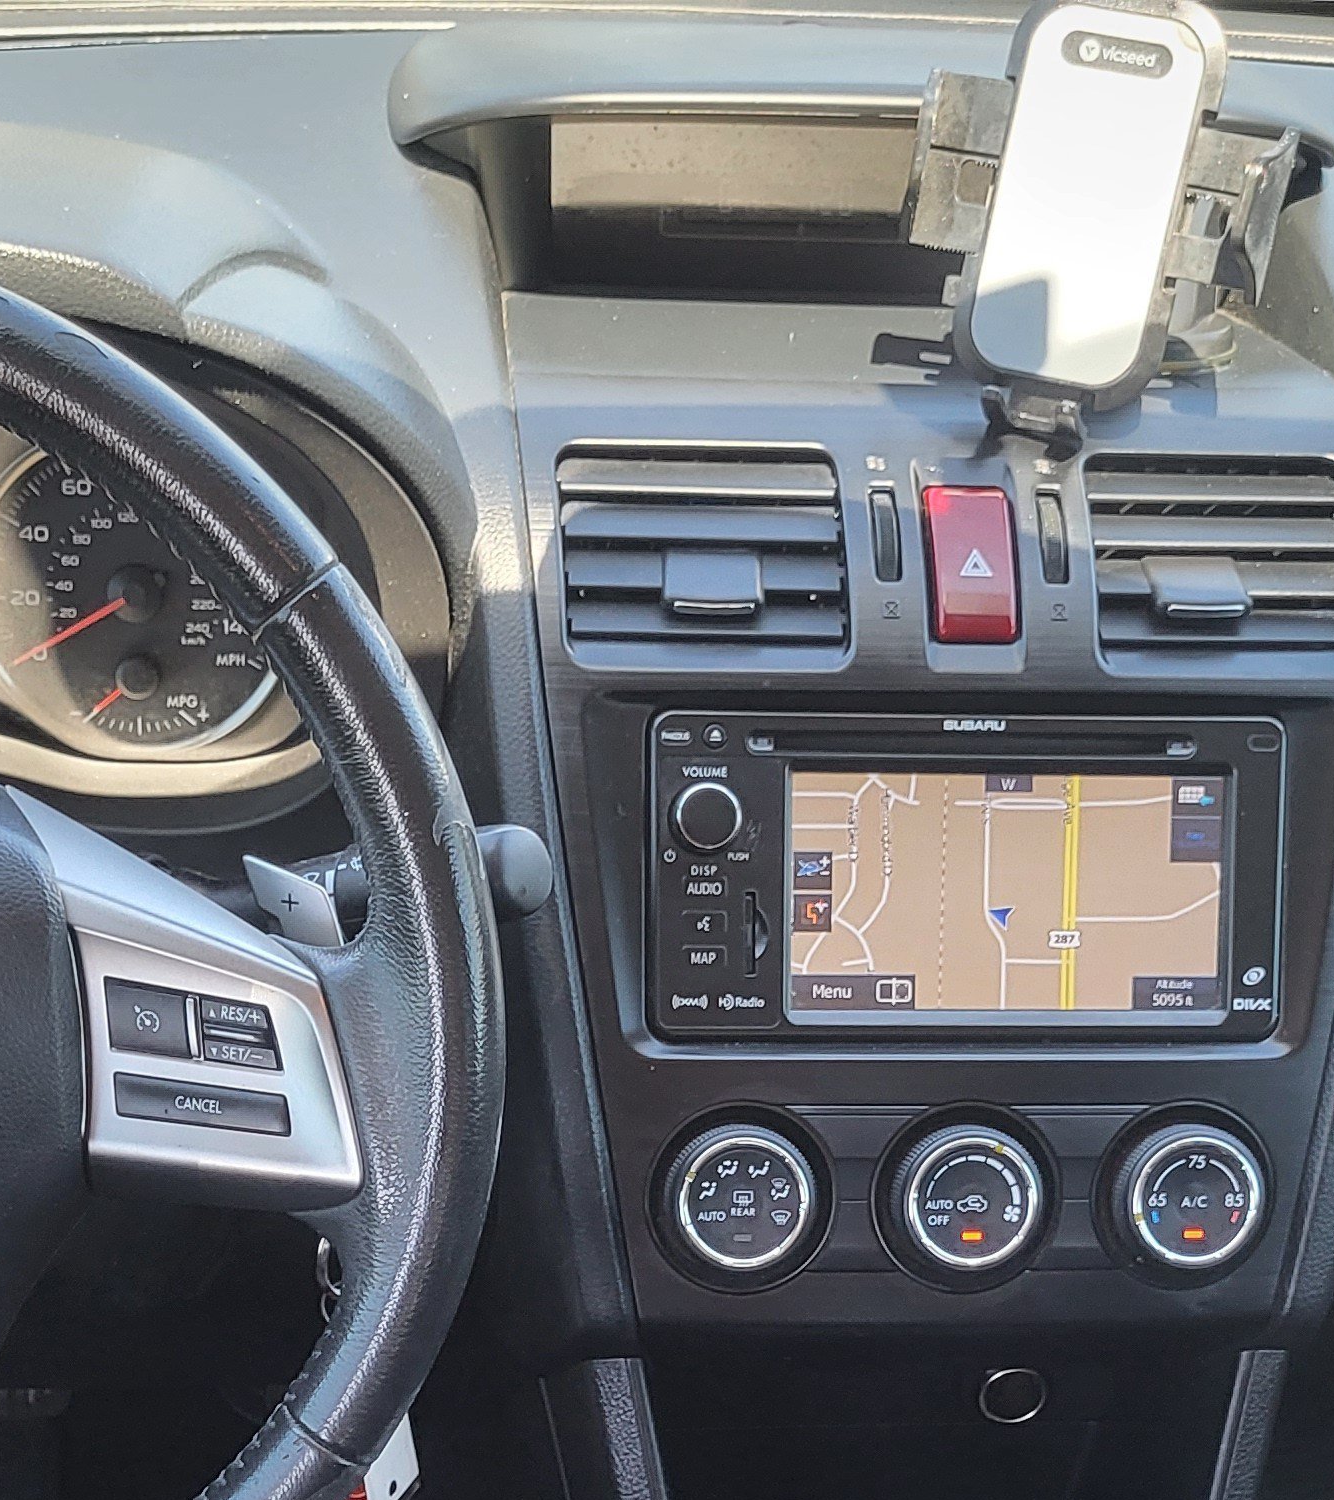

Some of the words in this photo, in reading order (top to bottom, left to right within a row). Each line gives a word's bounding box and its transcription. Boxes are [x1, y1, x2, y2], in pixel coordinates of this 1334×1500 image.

[1102, 45, 1157, 68] vicseed
[61, 479, 92, 496] 60
[91, 518, 113, 530] 100
[19, 525, 50, 543] 40
[72, 534, 91, 545] 80
[54, 580, 74, 592] 40
[10, 590, 40, 606] 20
[190, 599, 215, 611] 220
[222, 618, 249, 635] 14
[217, 653, 246, 667] MPH
[167, 694, 199, 709] MPG
[943, 719, 1007, 732] SUBARU
[681, 765, 728, 778] VOLUME
[1000, 778, 1017, 791] W
[727, 852, 750, 861] PUSH
[690, 864, 718, 877] DISP
[686, 882, 723, 895] AUDIO
[690, 952, 717, 965] MAP
[812, 984, 853, 999] Menu
[1152, 993, 1183, 1007] 5095
[174, 1095, 222, 1115] CANCEL
[1187, 1155, 1207, 1169] 75
[924, 1198, 955, 1211] AUTO
[1147, 1193, 1169, 1208] 65
[1181, 1194, 1208, 1210] A/C
[1223, 1193, 1246, 1208] 85
[697, 1209, 727, 1222] AUTO
[729, 1207, 756, 1218] REAR
[927, 1214, 951, 1227] OFF
